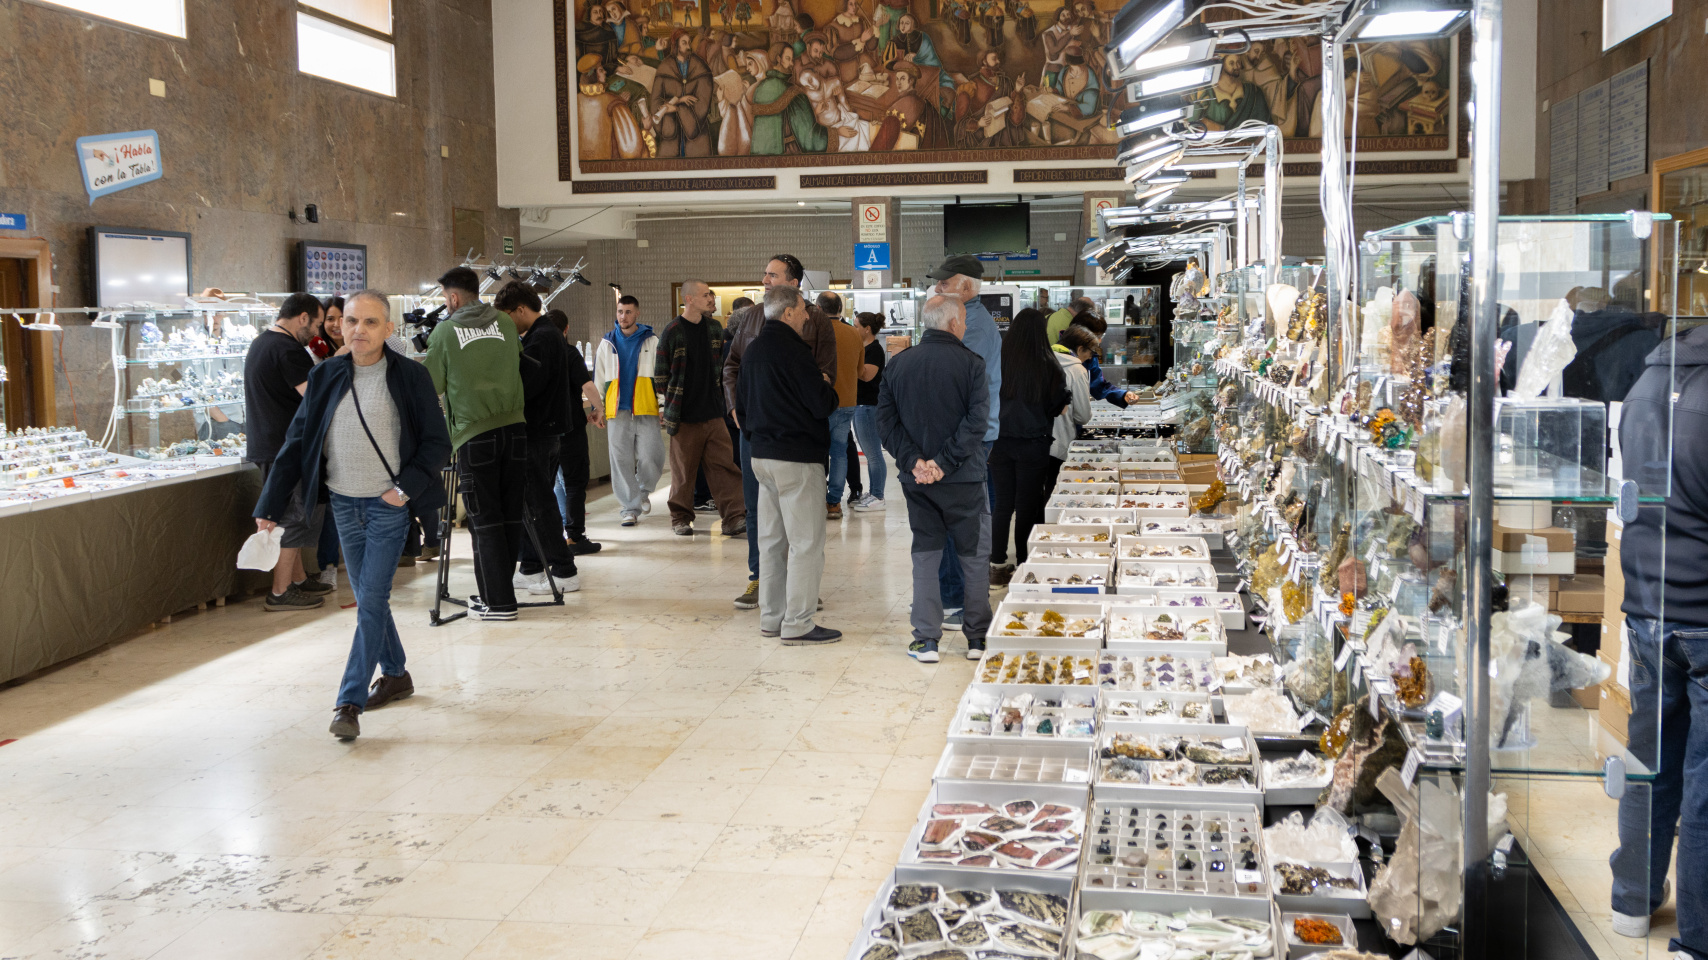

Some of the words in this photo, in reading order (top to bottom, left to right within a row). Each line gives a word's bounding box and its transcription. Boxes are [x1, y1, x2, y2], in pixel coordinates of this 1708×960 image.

[114, 143, 153, 164] ¡Habla
[94, 174, 114, 187] con
[117, 168, 127, 180] la
[128, 160, 156, 177] Tabla!
[867, 248, 878, 263] A
